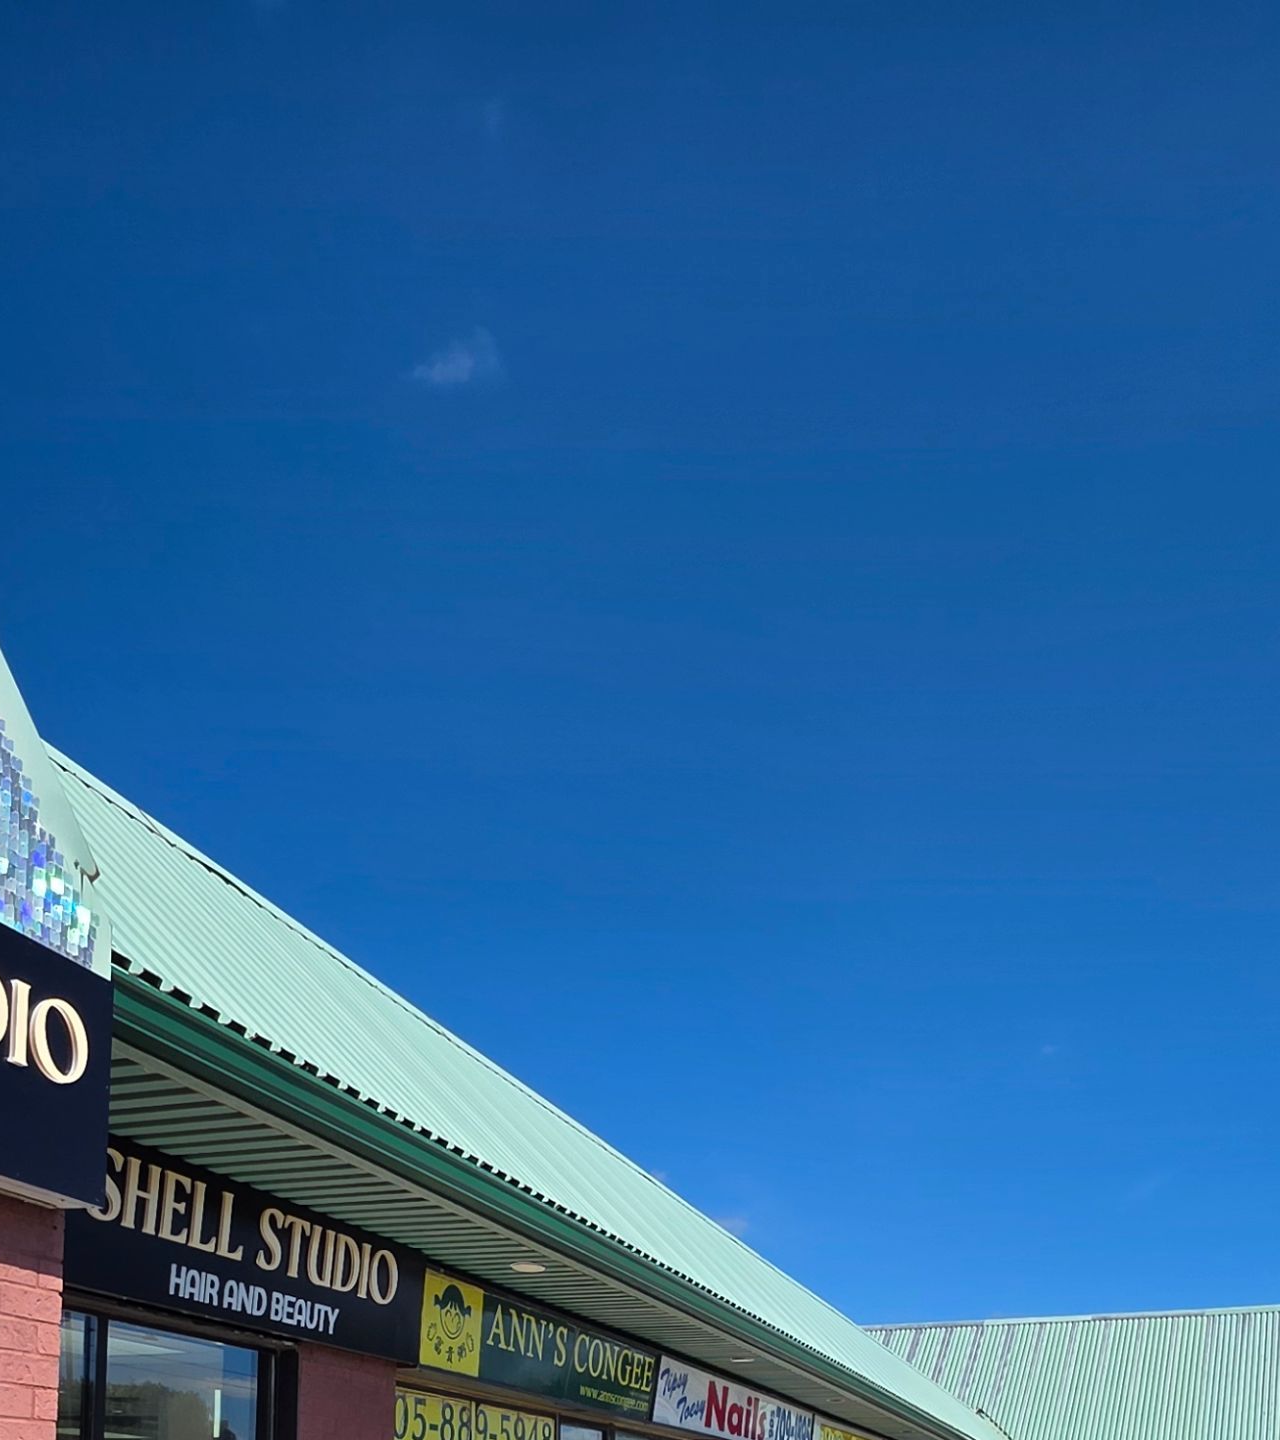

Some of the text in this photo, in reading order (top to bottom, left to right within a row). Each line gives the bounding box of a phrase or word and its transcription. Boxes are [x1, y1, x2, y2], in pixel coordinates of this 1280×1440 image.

[87, 1147, 398, 1305] SHELL STUDIO
[169, 1263, 339, 1335] HAIR AND BEAUTY
[486, 1304, 568, 1368] ANN'S
[574, 1334, 655, 1392] CONGEE
[660, 1368, 688, 1399] Tipsy
